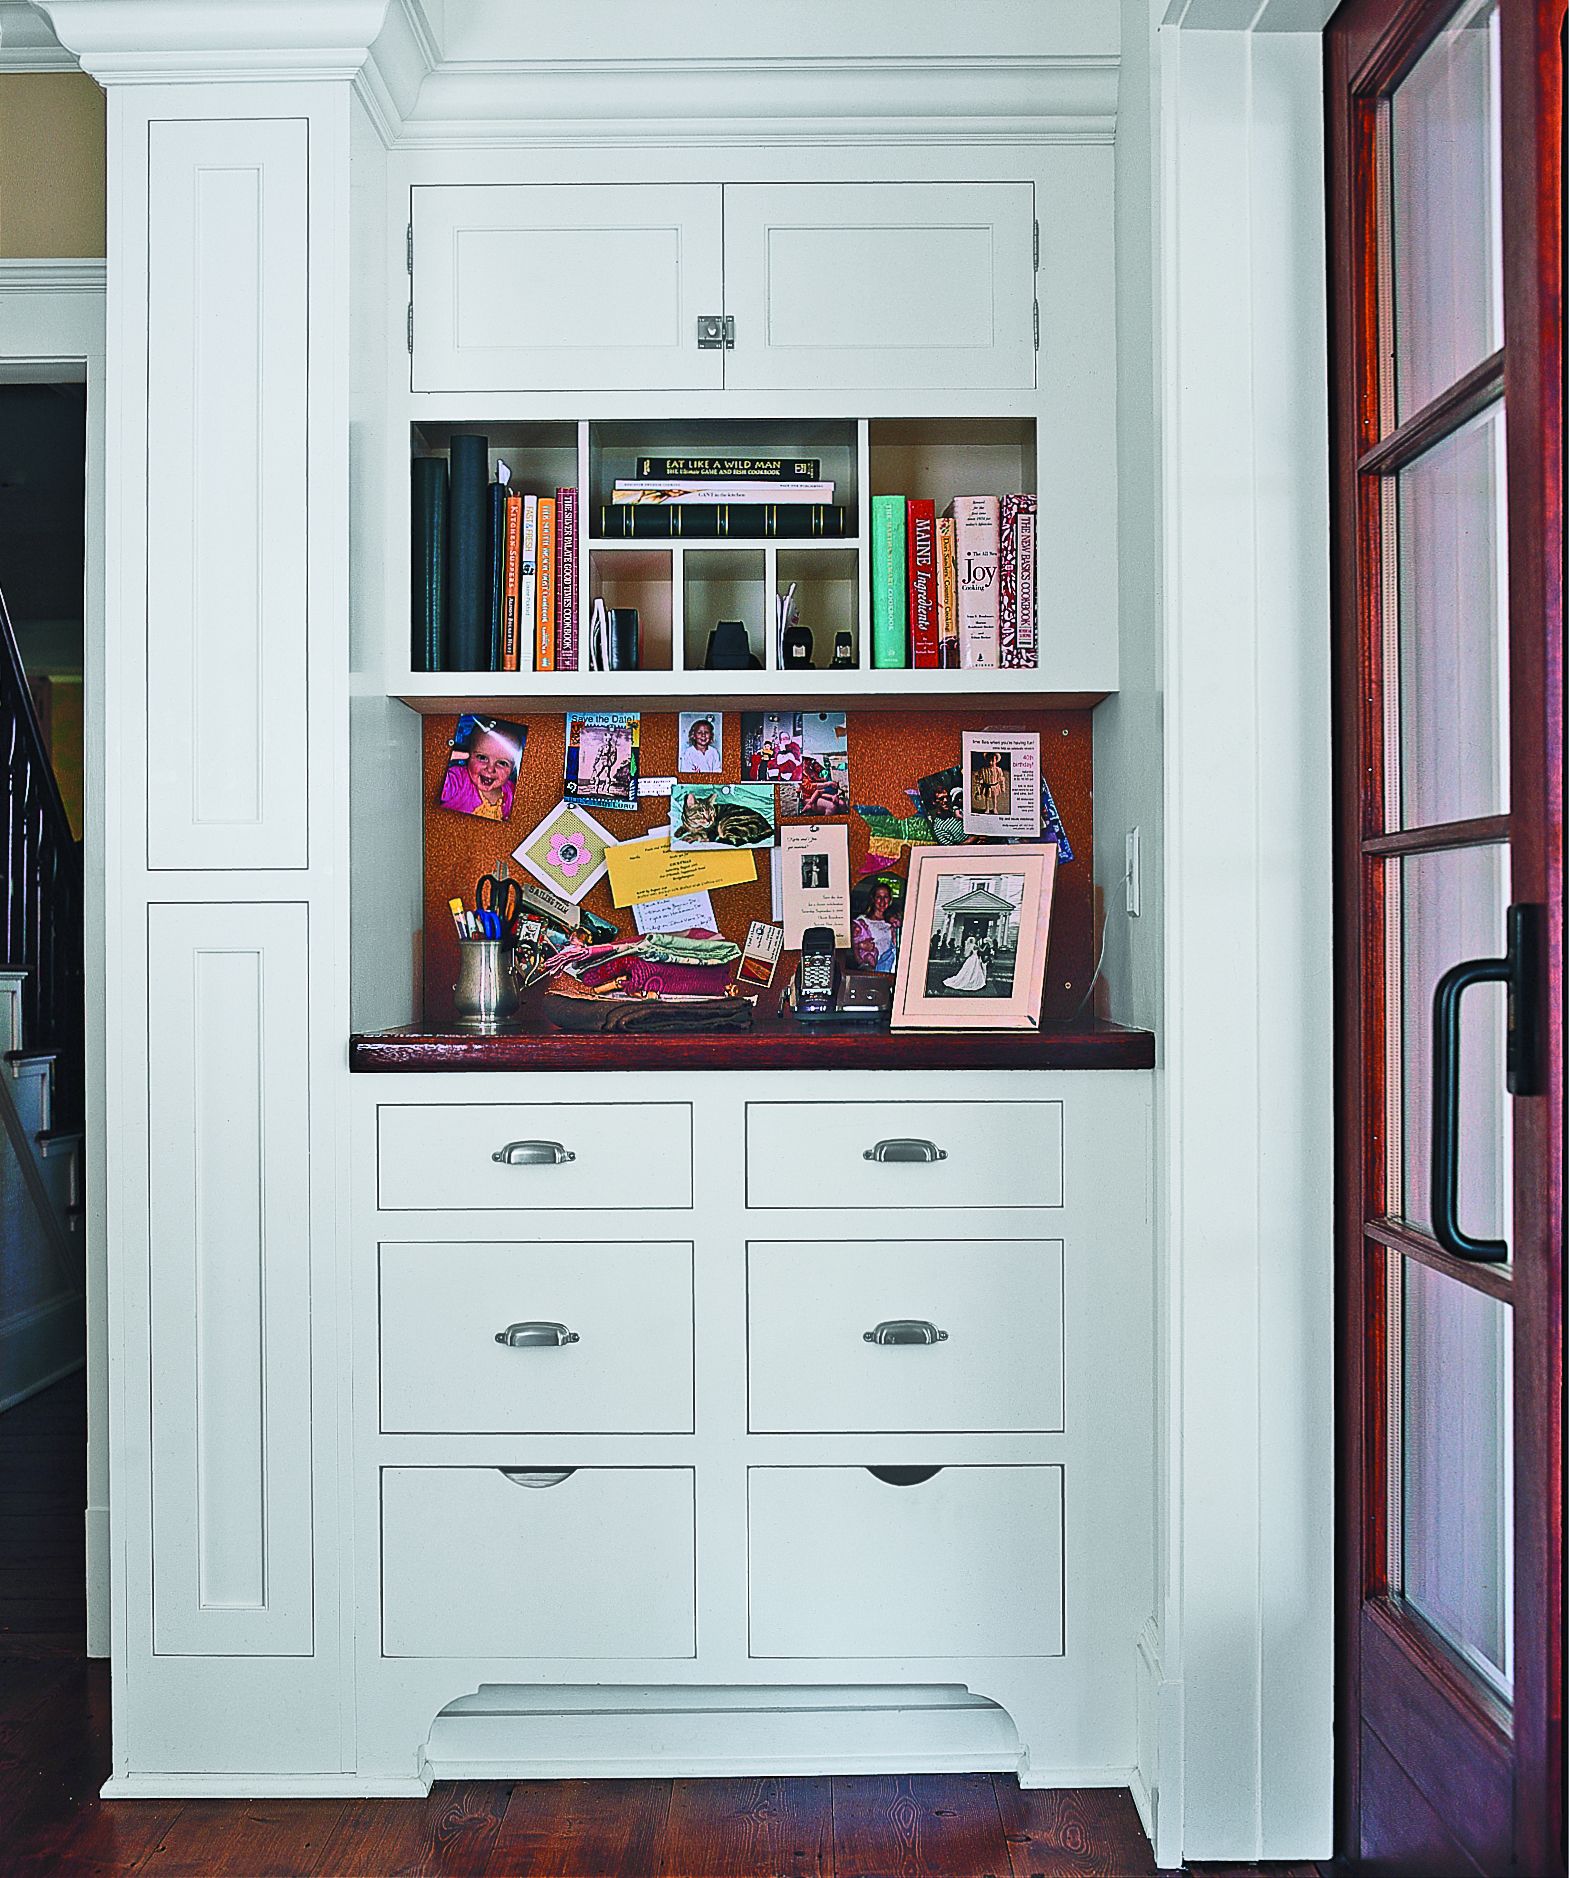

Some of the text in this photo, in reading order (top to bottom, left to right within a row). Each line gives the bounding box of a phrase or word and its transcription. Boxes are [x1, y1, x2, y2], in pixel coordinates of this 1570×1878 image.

[666, 459, 781, 469] EAT LIKE A WILD MAN
[700, 468, 719, 476] GAME
[718, 468, 733, 476] AND
[733, 468, 747, 476] FISH
[747, 468, 781, 476] COOKBOOK
[563, 495, 573, 511] THE
[525, 506, 533, 524] FAST
[563, 511, 573, 536] SILVER
[1020, 516, 1031, 534] THE
[507, 505, 519, 588] KITCHEN SUPPERS
[524, 529, 533, 552] FRESH
[563, 536, 573, 563] PALATE
[915, 518, 931, 566] MAINE
[1020, 534, 1031, 553] NEW
[563, 563, 573, 585] GOOD
[961, 558, 998, 588] Joy
[1020, 554, 1031, 581] BASICS
[563, 585, 573, 608] TIMES
[961, 584, 985, 592] Cooking
[887, 588, 895, 631] COOKBOOK
[913, 570, 933, 631] Ingredients
[1020, 581, 1031, 626] COOKBOOK
[563, 608, 573, 649] COOKBOOK
[571, 715, 636, 724] Save the Date!
